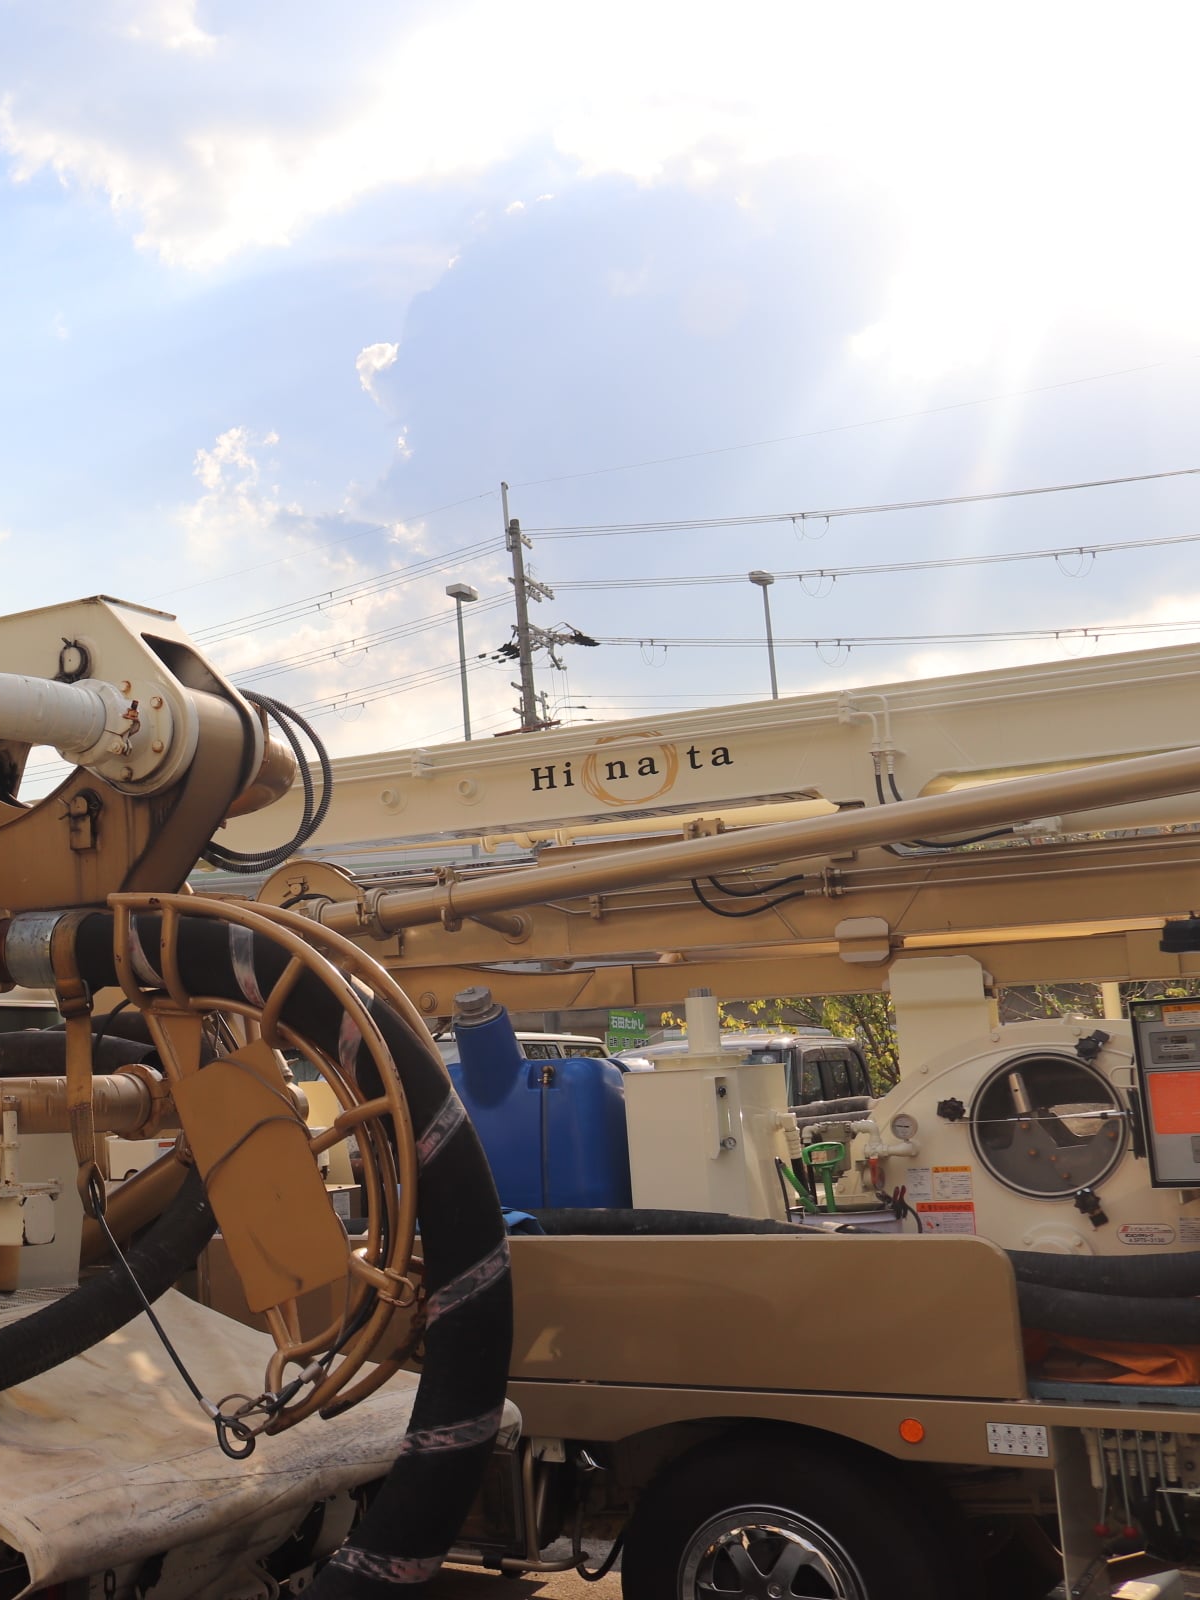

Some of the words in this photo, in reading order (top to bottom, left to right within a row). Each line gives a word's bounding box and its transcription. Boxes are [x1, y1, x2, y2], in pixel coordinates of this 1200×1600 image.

[611, 1015, 644, 1030] 石田たかし
